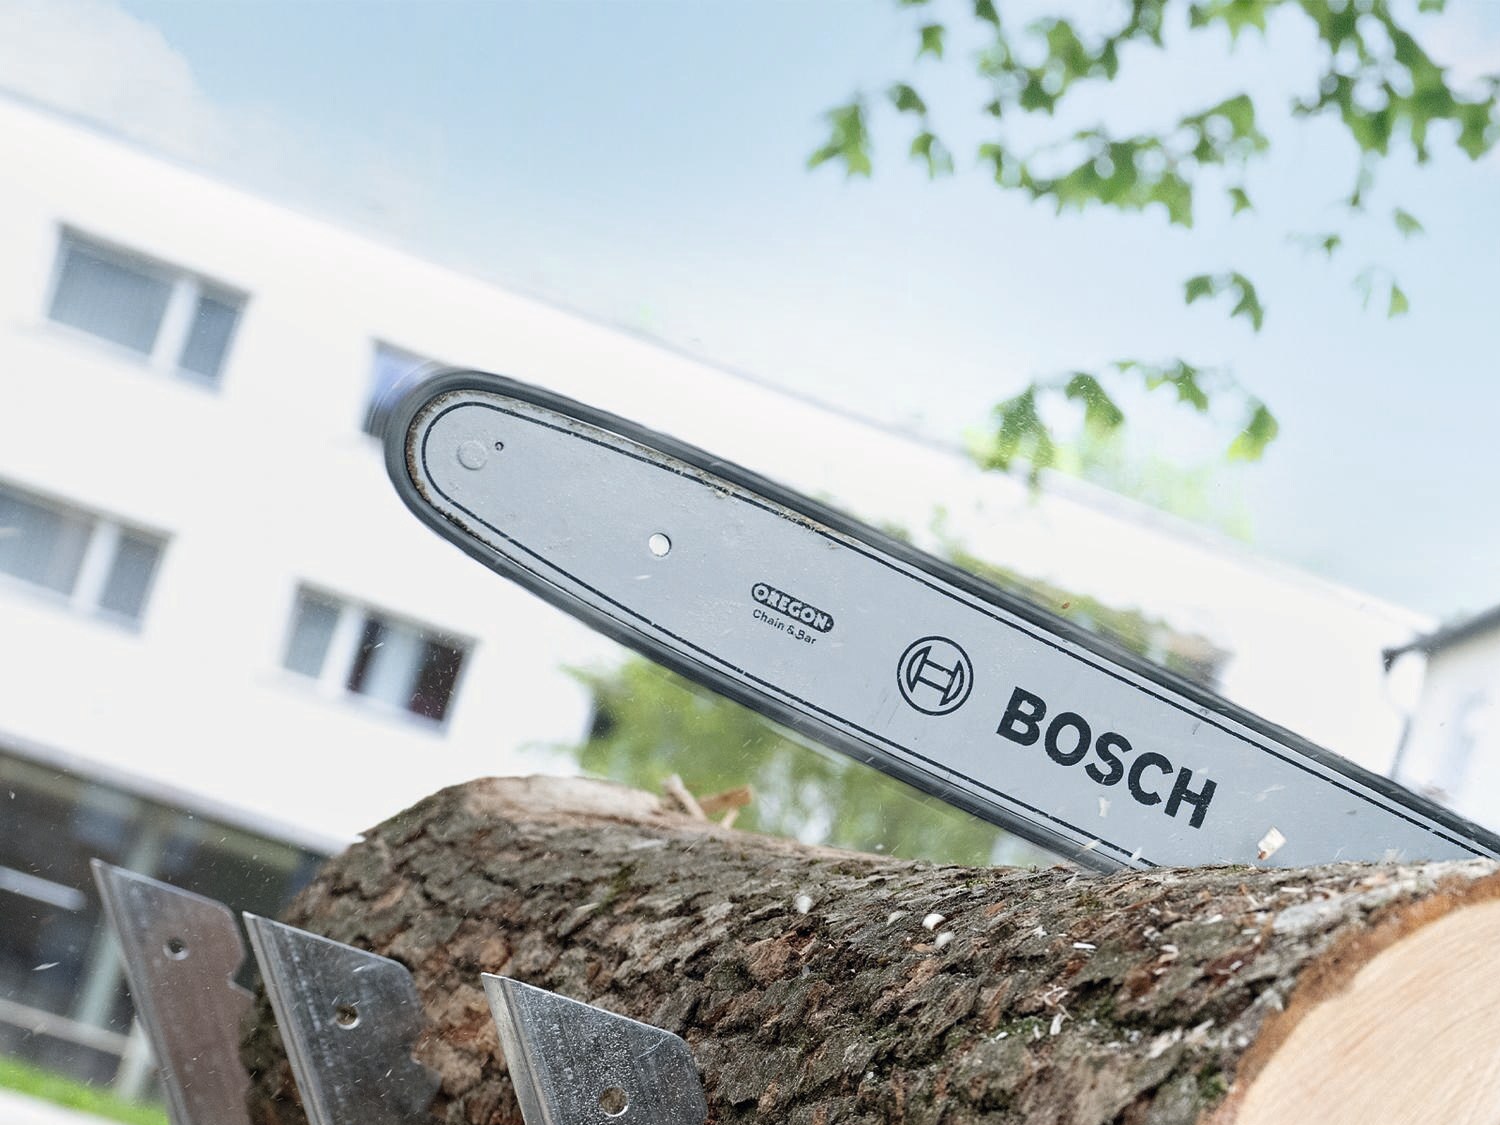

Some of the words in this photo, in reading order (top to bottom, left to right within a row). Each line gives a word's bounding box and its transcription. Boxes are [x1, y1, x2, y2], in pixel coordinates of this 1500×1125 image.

[752, 583, 834, 633] OREGON
[752, 608, 785, 631] Chain
[786, 624, 795, 636] &
[795, 629, 817, 645] Bar
[996, 686, 1218, 829] BOSCH
